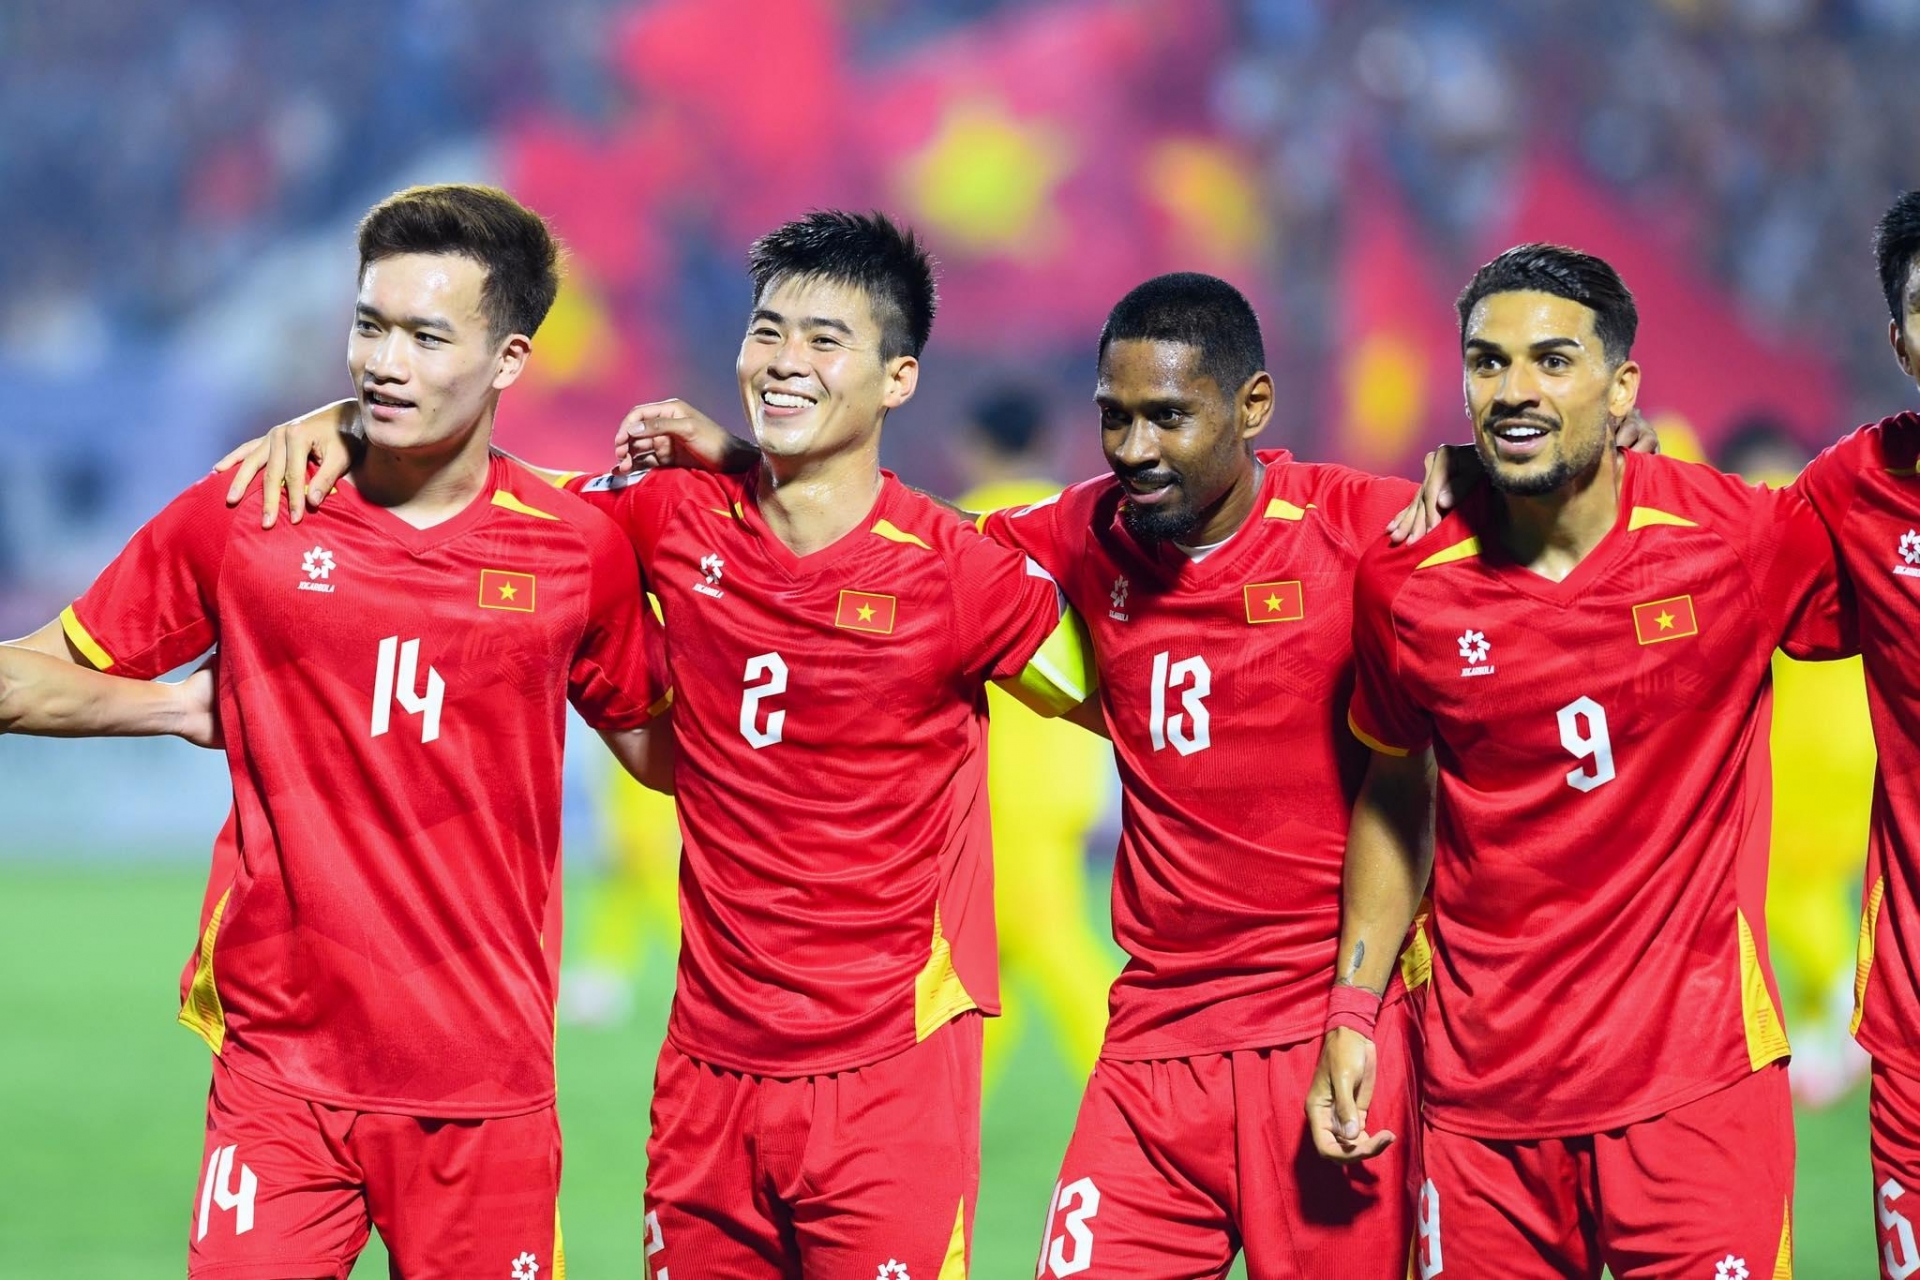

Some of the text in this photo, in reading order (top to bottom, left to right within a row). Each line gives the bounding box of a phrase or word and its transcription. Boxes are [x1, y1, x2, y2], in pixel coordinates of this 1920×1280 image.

[370, 636, 446, 744] 14
[740, 651, 788, 749] 2
[1149, 650, 1212, 757] 13
[1556, 695, 1615, 793] 9
[197, 1143, 258, 1244] 14
[1037, 1176, 1101, 1280] 13
[1418, 1177, 1444, 1280] 9
[1878, 1177, 1920, 1280] 5
